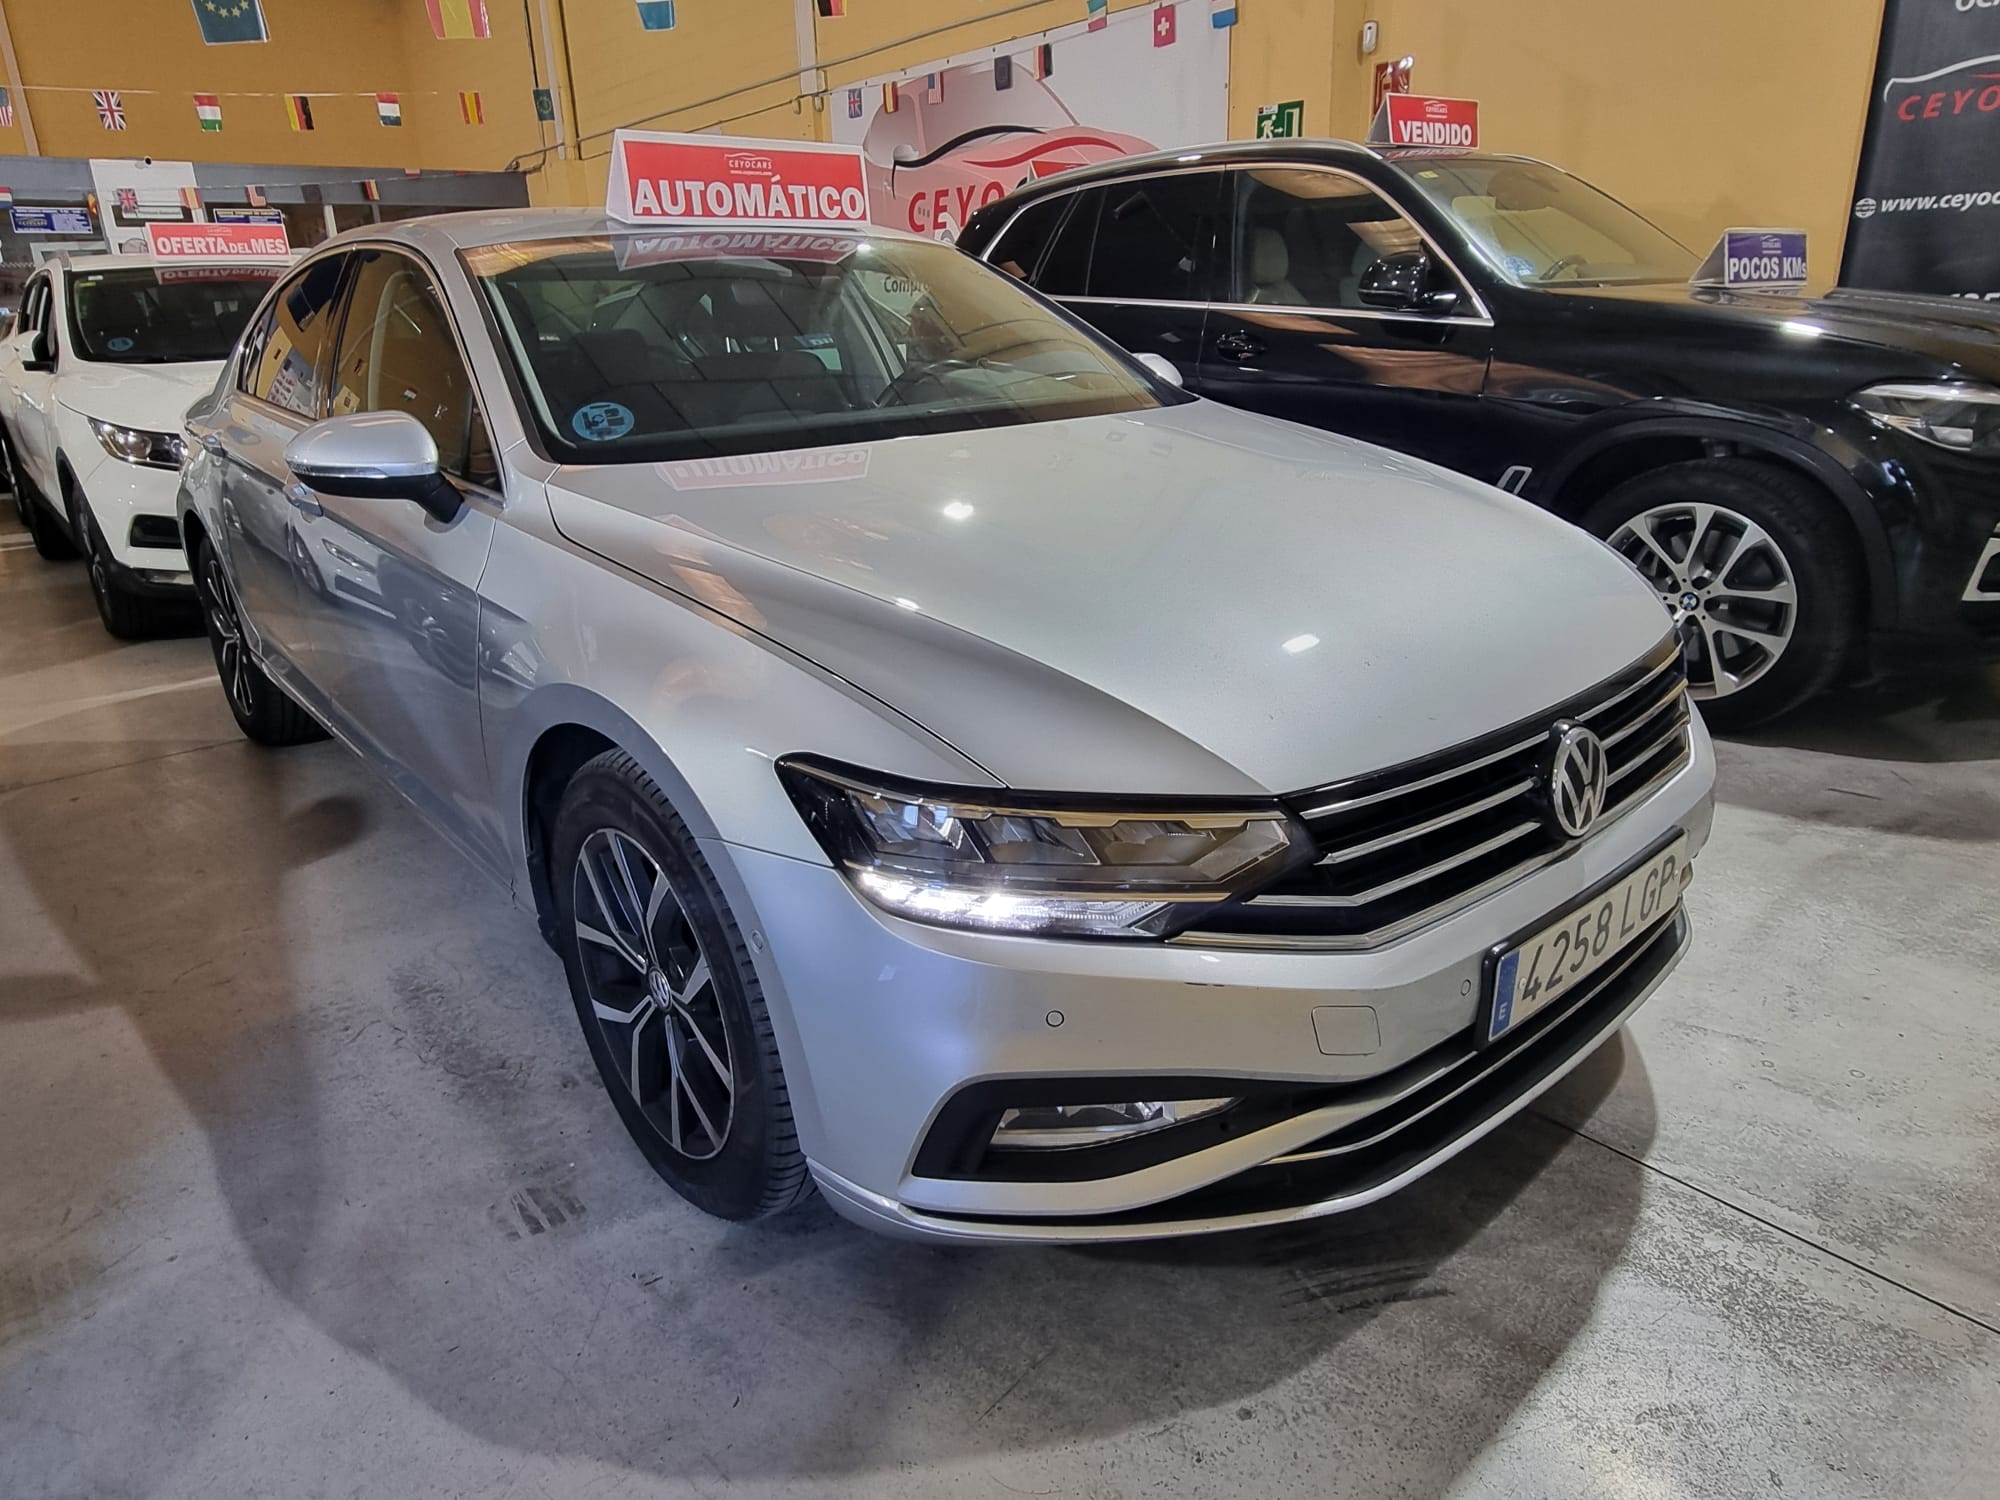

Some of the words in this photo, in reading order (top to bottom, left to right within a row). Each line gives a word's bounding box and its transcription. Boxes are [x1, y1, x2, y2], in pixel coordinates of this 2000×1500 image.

[1897, 84, 2000, 121] CEYO
[1398, 119, 1473, 146] VENDIDO
[633, 173, 865, 220] AUTOMÁTICO
[156, 236, 229, 254] OFERTA
[229, 242, 252, 254] DEL
[250, 238, 287, 254] MES
[1729, 256, 1780, 281] POCOS
[1782, 256, 1807, 279] KMs
[1521, 900, 1613, 1001] 4258
[1619, 854, 1676, 939] LGP
